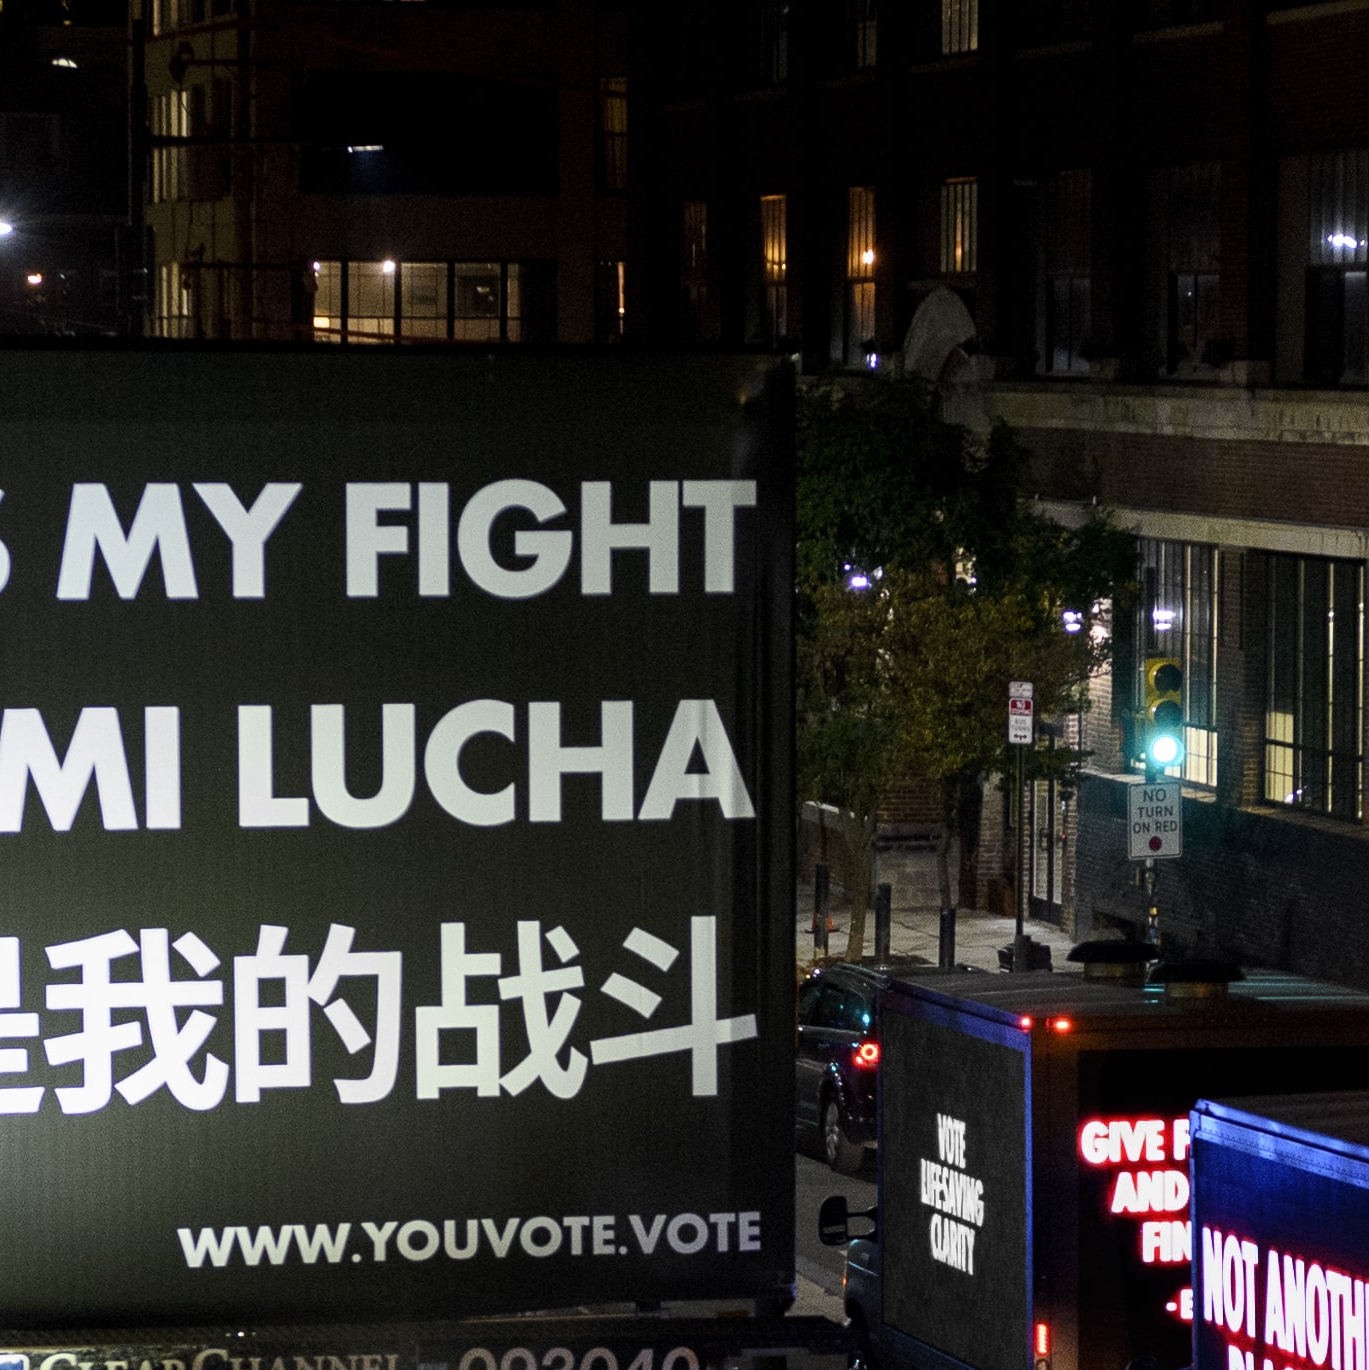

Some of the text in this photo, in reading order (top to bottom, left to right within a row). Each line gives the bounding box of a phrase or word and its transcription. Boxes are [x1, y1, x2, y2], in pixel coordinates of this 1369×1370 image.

[55, 482, 303, 601] MY
[345, 479, 757, 599] FIGHT
[237, 699, 756, 830] LUCHA
[1137, 805, 1174, 818] TURN
[1143, 788, 1166, 802] NO
[1133, 820, 1178, 834] ON RED
[936, 1112, 967, 1170] VOTE
[1081, 1119, 1165, 1164] GIVE
[1111, 1170, 1190, 1214] AND
[176, 1213, 762, 1268] WWW.YOUVOTE.VOTE
[929, 1212, 976, 1277] CLARITY
[1142, 1220, 1192, 1263] FIN
[1202, 1226, 1259, 1338] NOT
